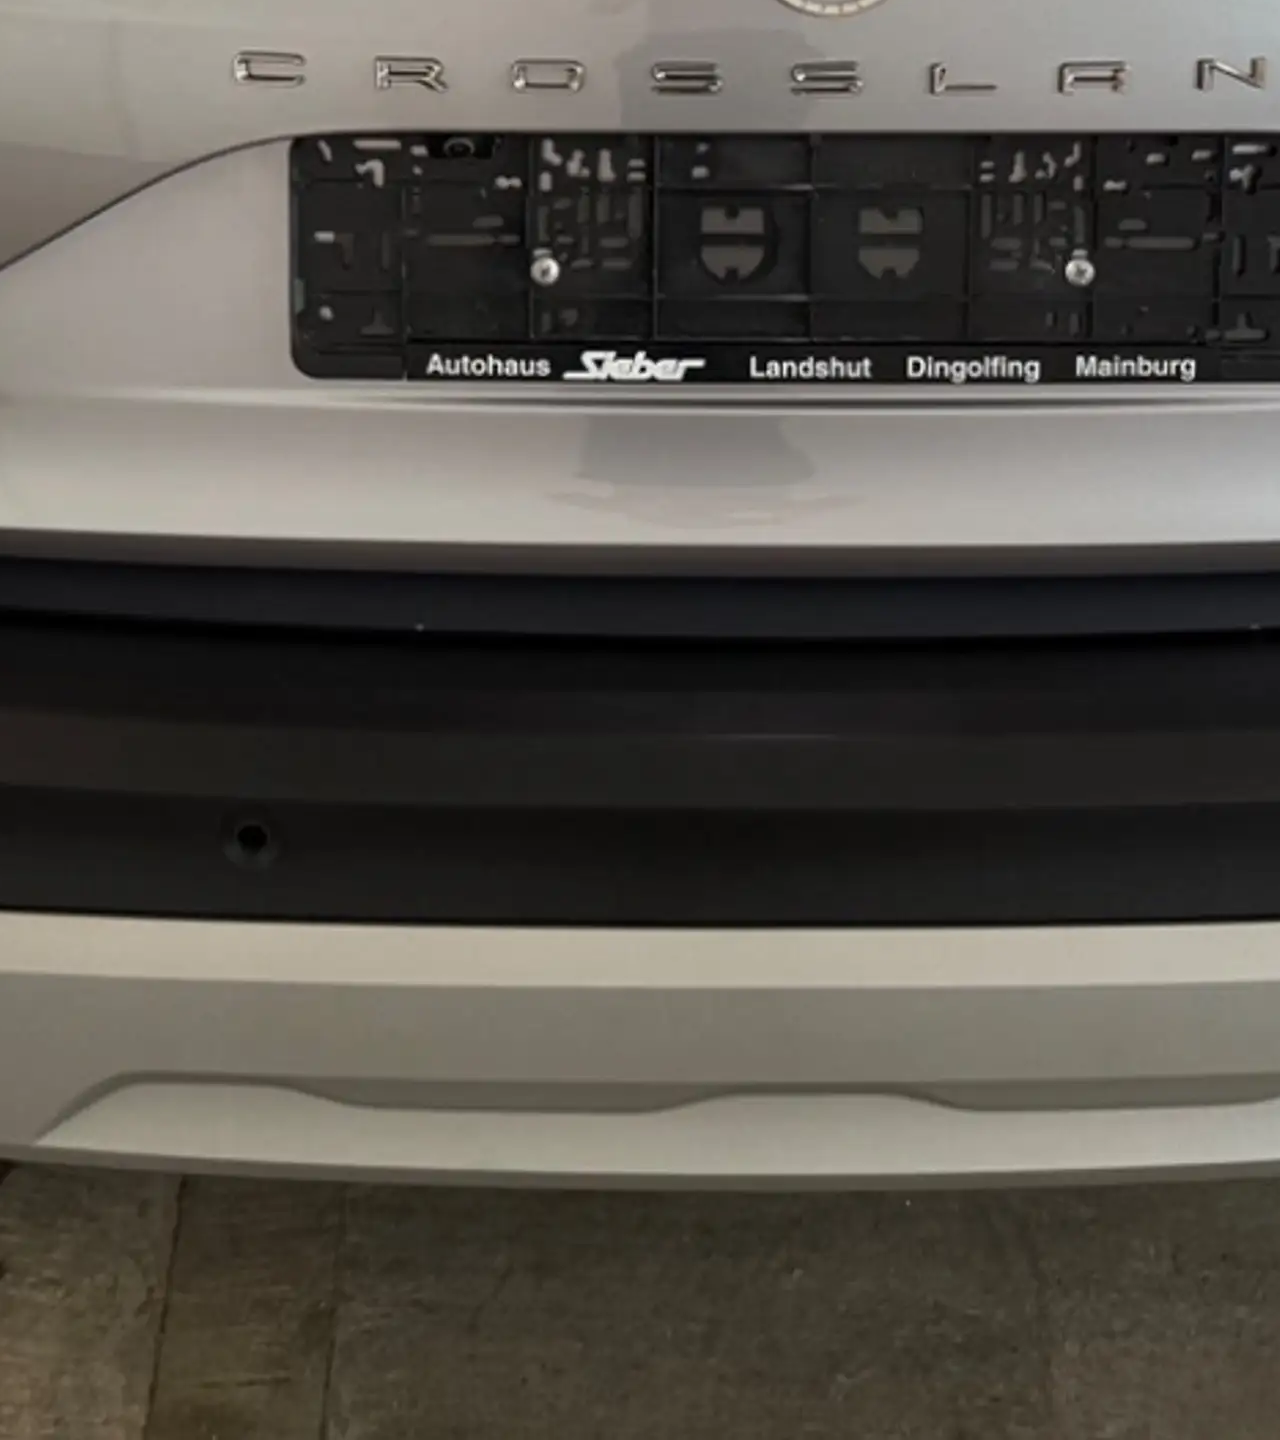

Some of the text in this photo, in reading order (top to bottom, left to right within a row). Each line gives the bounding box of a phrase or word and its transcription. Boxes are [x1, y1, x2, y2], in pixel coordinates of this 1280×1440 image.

[426, 350, 1196, 383] Autohaus Sieber Landshut Dingolfing Mainburg
